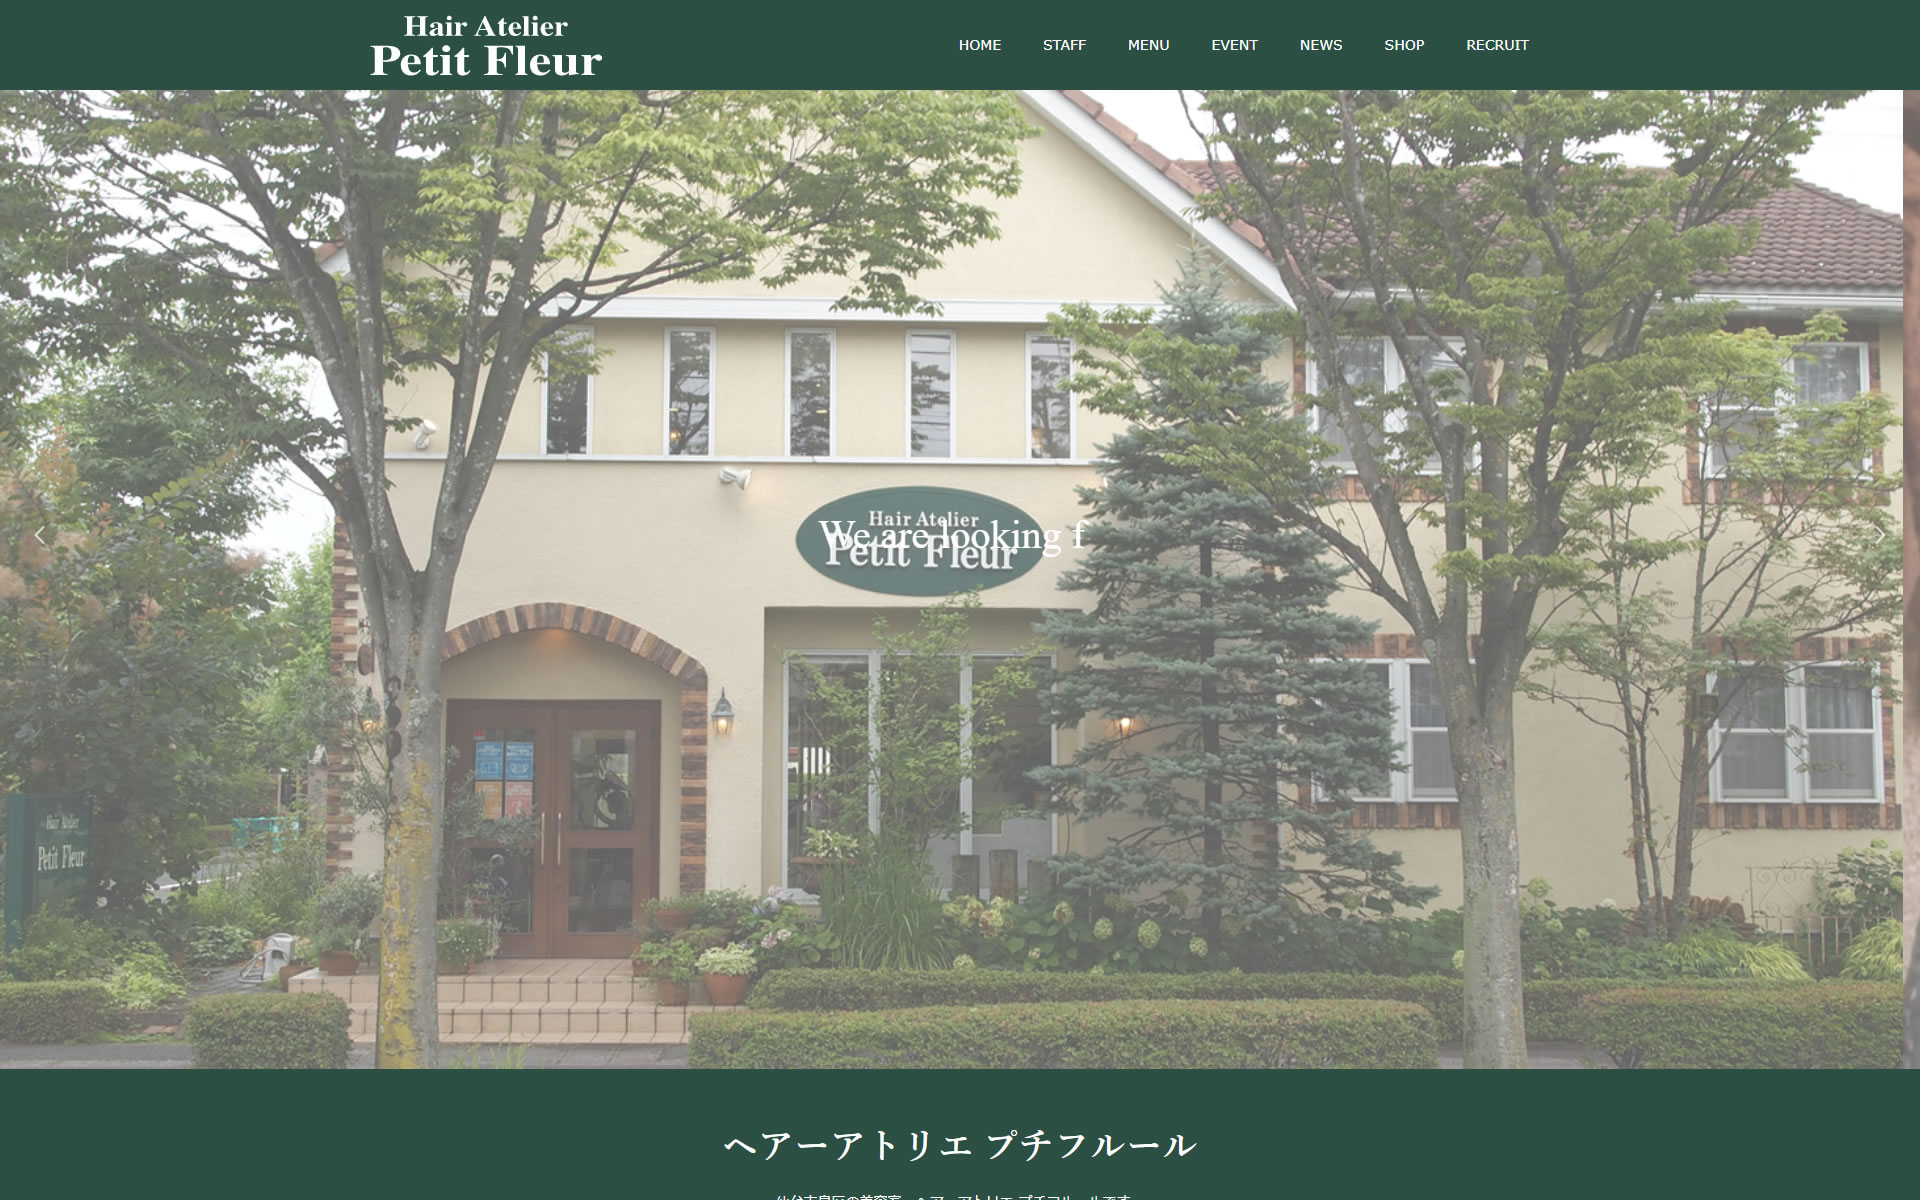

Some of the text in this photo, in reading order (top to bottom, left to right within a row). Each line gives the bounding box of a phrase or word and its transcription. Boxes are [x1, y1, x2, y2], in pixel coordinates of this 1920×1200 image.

[868, 510, 980, 529] Hair Atelier
[825, 532, 1019, 571] Petit Fleur
[37, 844, 86, 871] Petit Fleur
